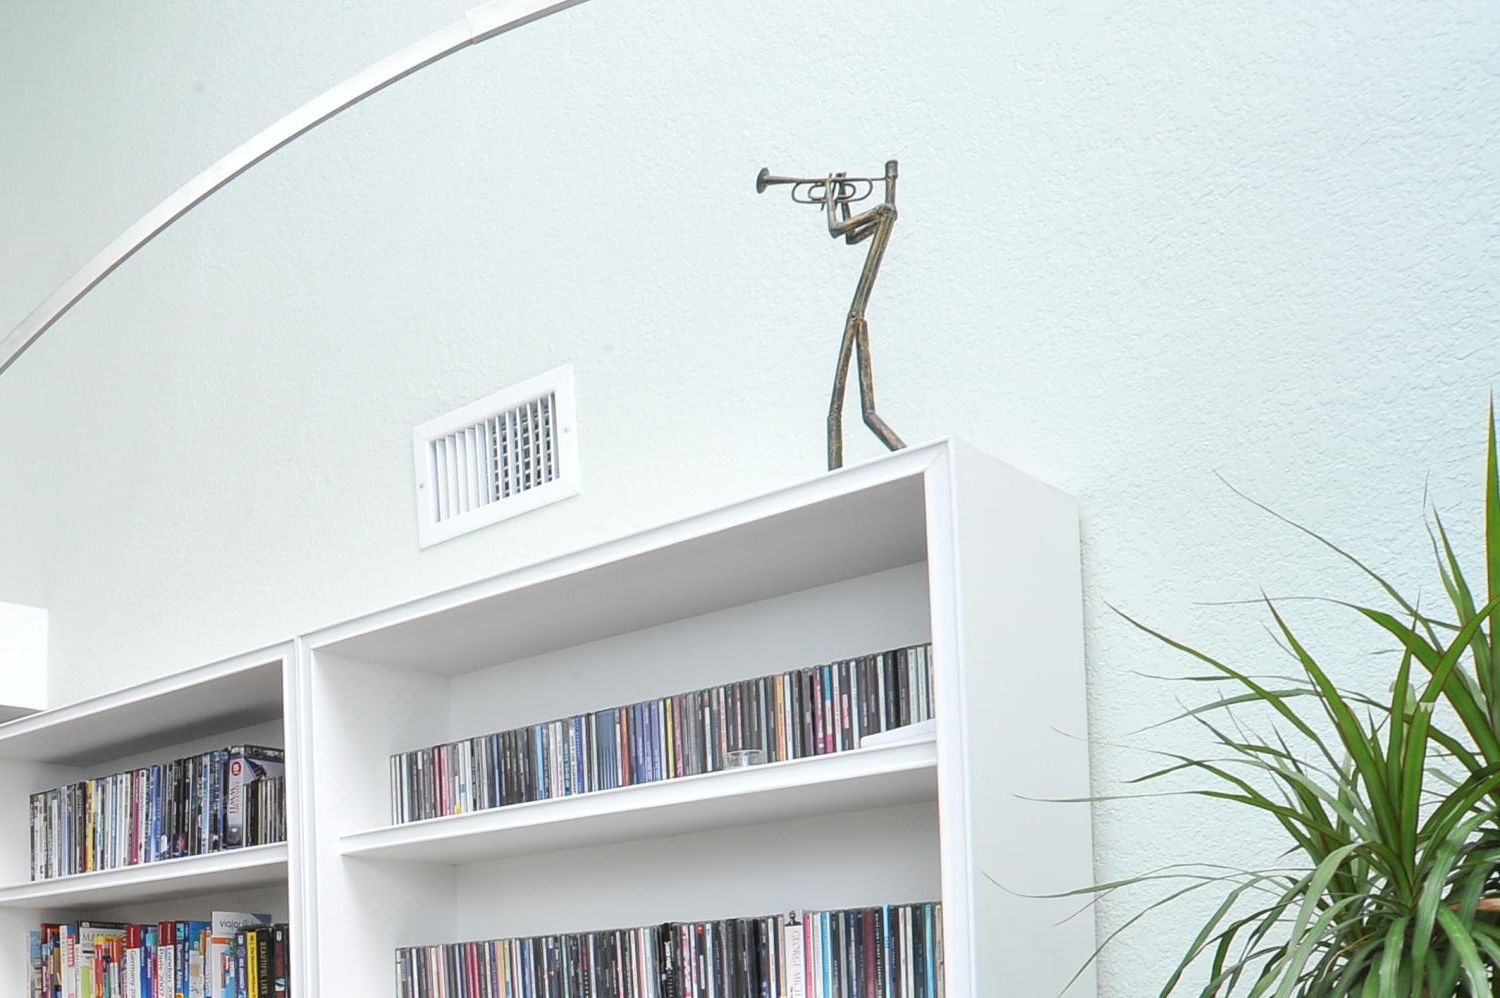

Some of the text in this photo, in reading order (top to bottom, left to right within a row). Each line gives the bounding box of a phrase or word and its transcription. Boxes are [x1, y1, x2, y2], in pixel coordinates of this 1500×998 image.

[129, 949, 138, 986] Germany
[260, 942, 268, 995] BEAUTIFUL LIES
